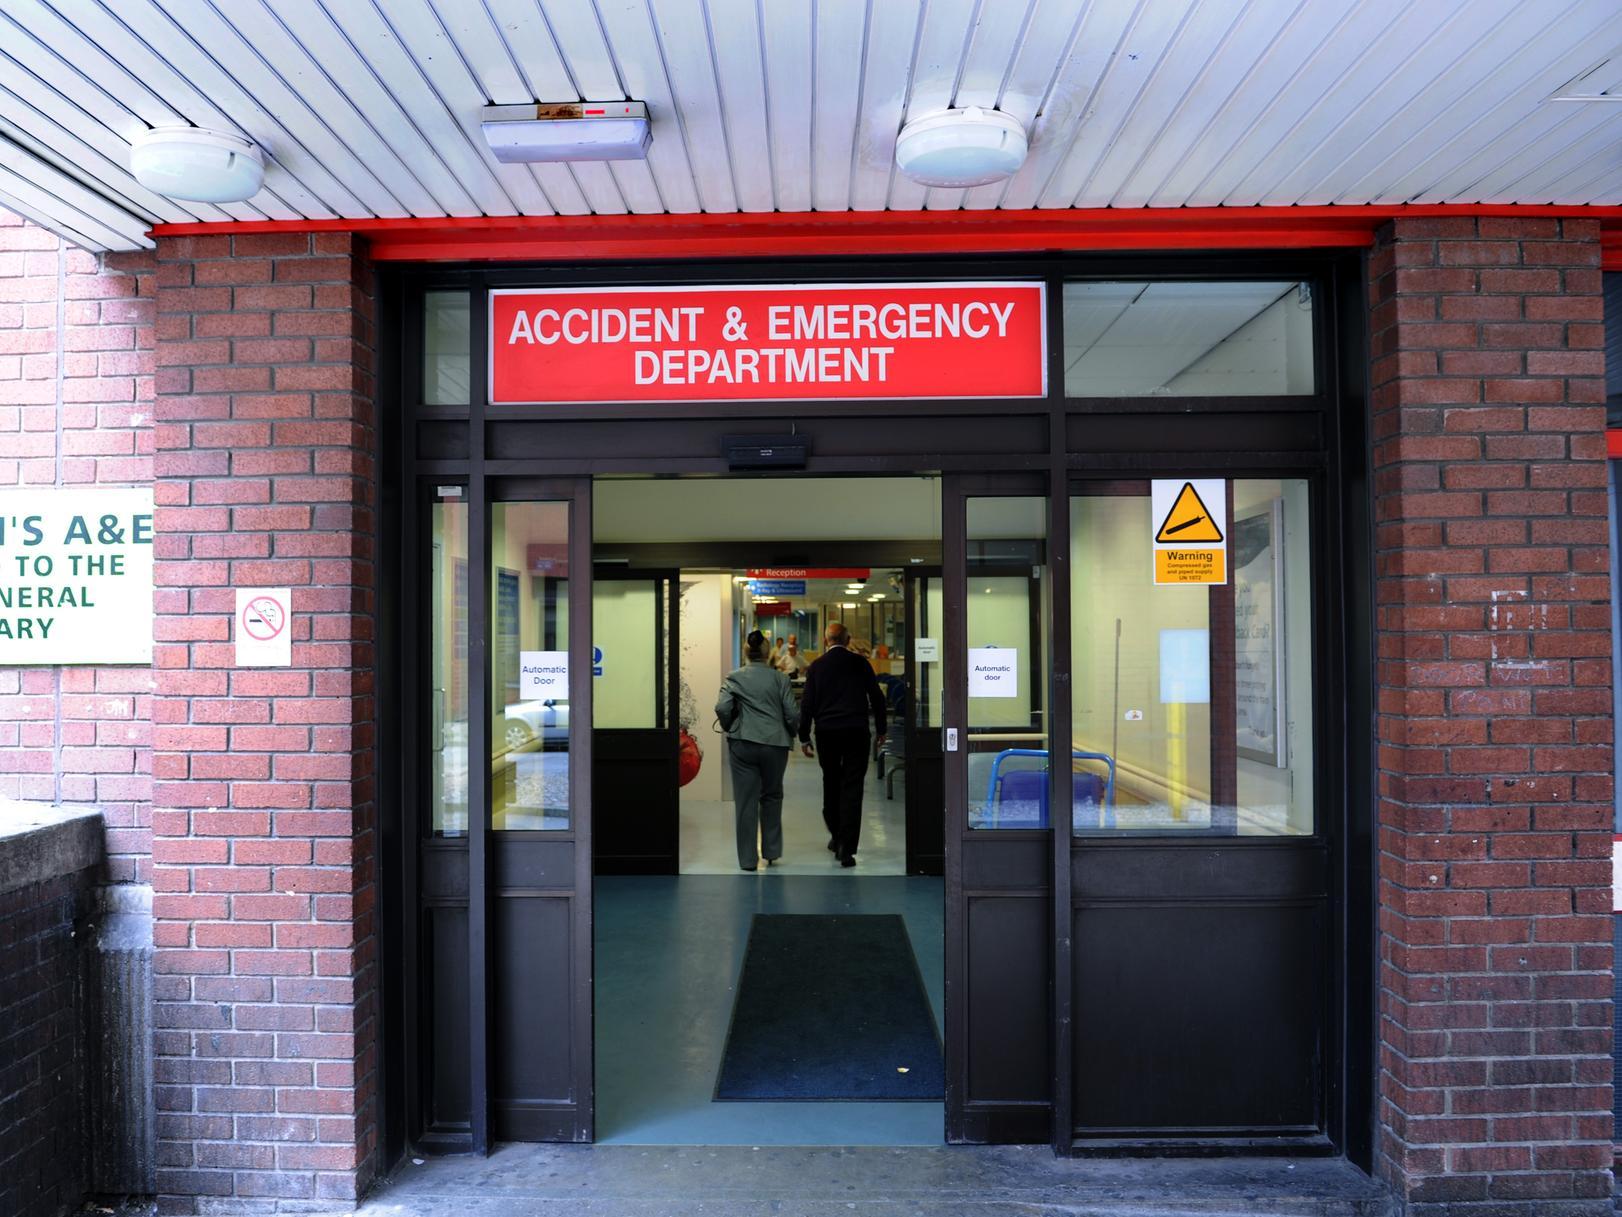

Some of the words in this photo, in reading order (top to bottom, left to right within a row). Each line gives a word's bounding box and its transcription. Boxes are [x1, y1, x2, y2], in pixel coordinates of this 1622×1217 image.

[508, 307, 704, 345] ACCIDENT
[722, 306, 748, 342] &
[768, 302, 1015, 341] EMERGENCY
[634, 346, 895, 385] DEPARTMENT
[63, 514, 152, 545] A&E
[1166, 551, 1213, 562] Warning
[15, 555, 54, 577] TO
[68, 554, 125, 576] THE
[766, 569, 806, 578] Reception
[522, 665, 566, 673] Automatic
[533, 676, 555, 684] Door
